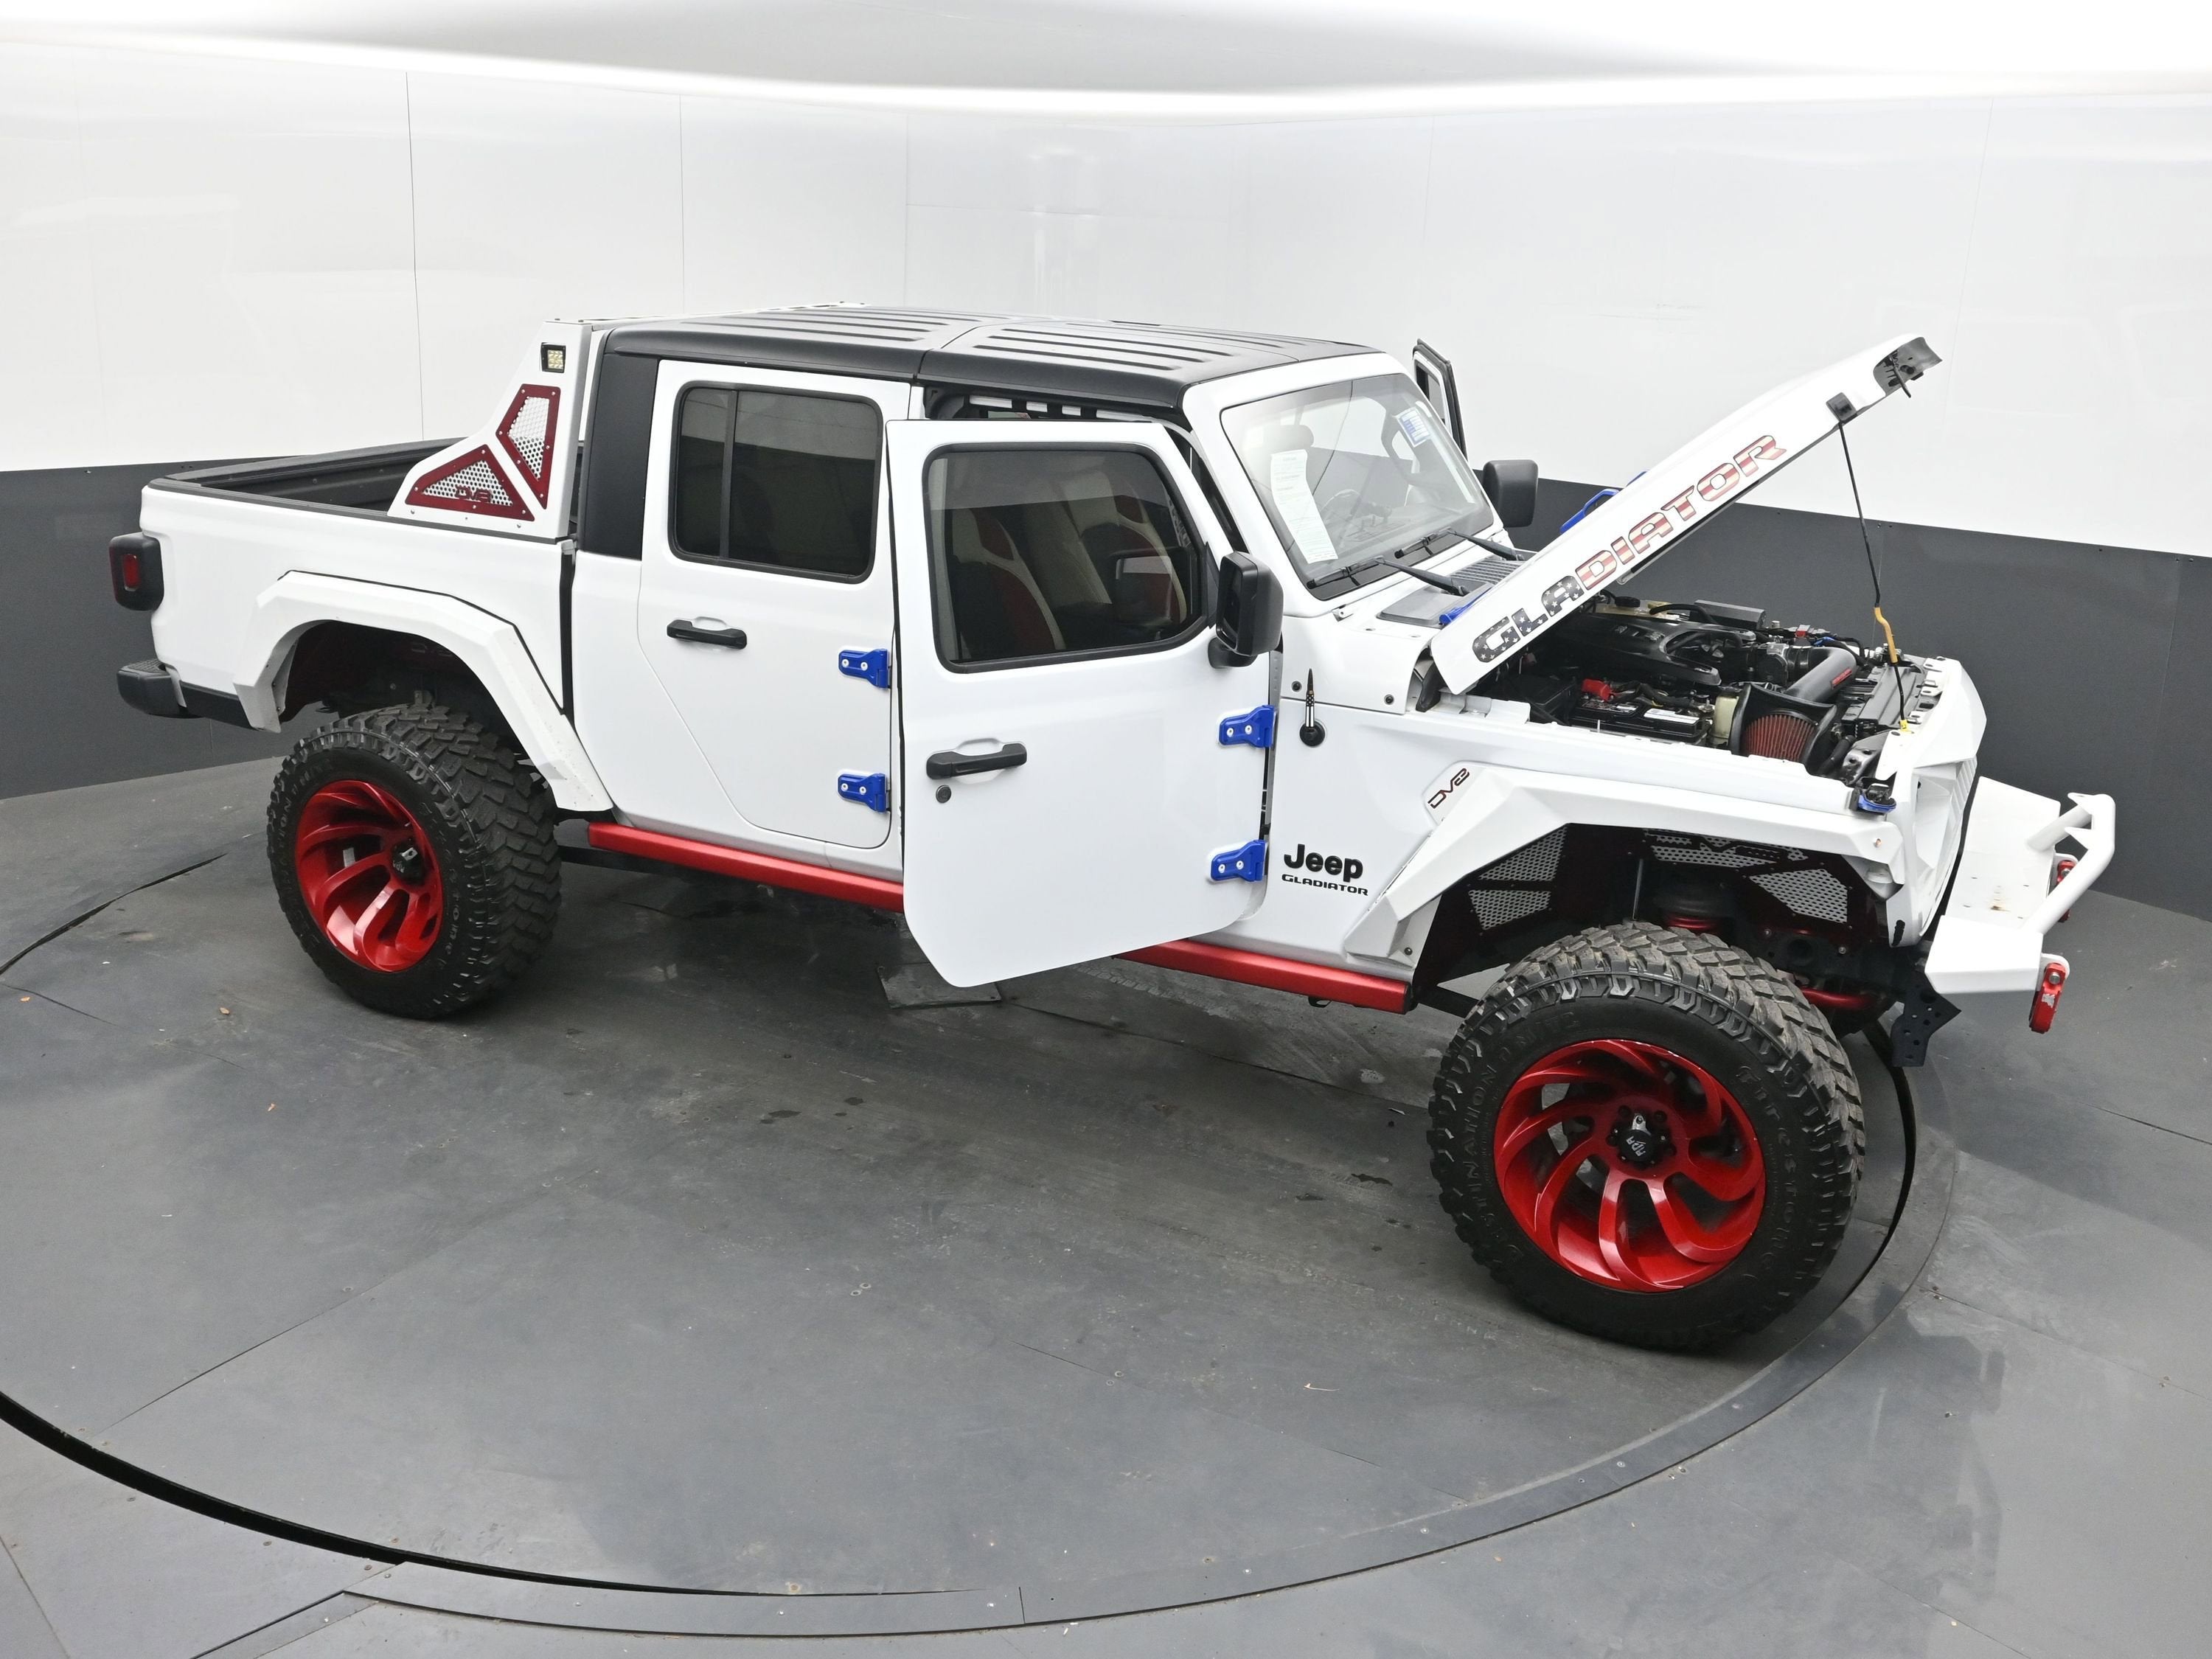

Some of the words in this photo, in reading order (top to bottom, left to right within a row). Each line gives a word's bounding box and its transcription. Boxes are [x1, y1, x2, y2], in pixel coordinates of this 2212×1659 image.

[1472, 435, 1787, 663] GLADIATOR
[1284, 844, 1363, 883] Jeep
[1281, 874, 1368, 896] GLADIATOR
